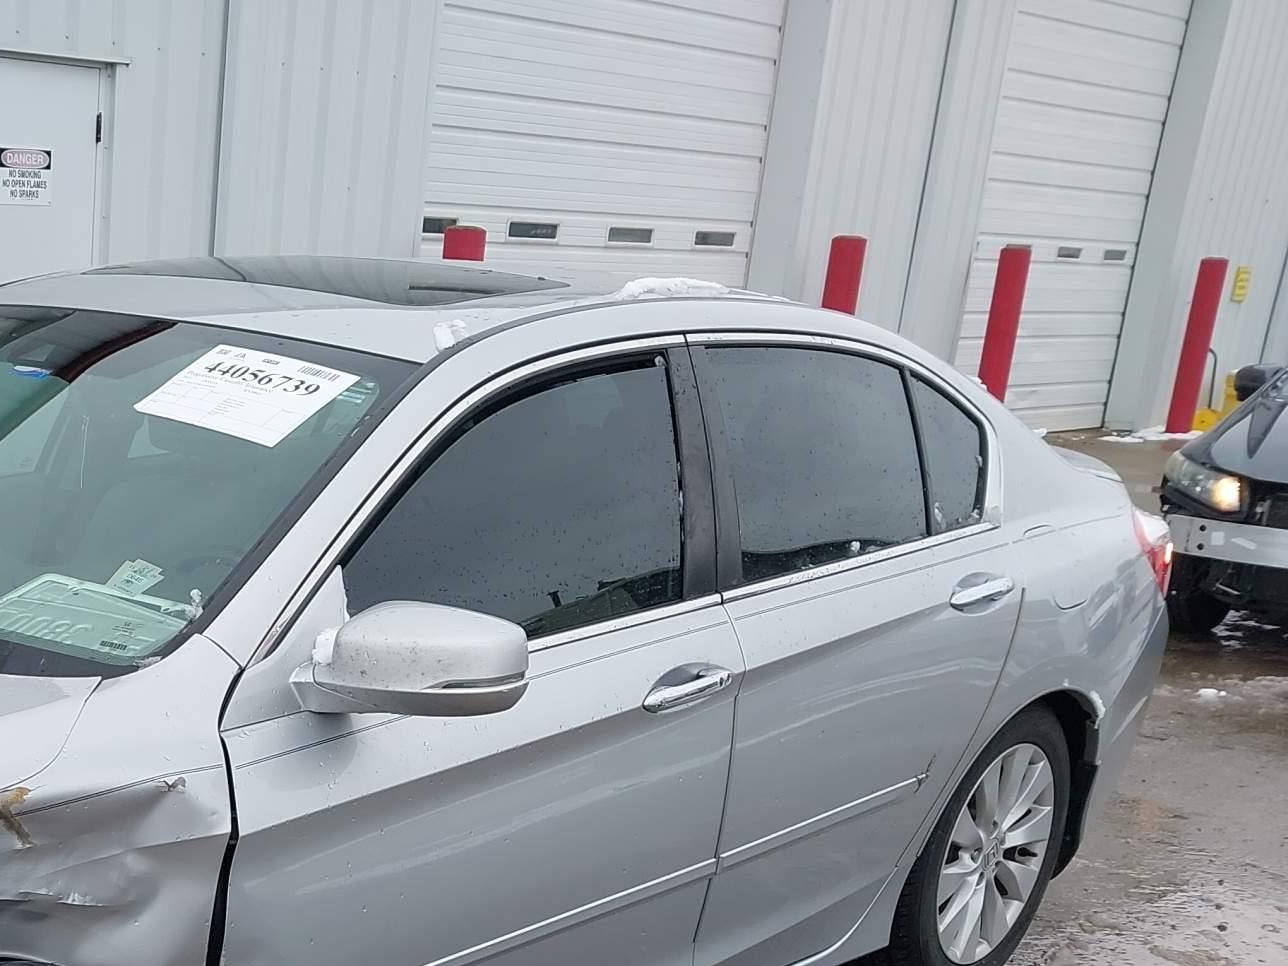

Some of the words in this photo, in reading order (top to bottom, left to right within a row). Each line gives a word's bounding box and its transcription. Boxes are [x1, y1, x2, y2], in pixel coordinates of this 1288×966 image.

[6, 152, 44, 164] DANGER
[9, 169, 17, 178] NO
[18, 170, 41, 179] SMOKING
[2, 179, 10, 187] NO
[11, 179, 26, 188] OPEN
[26, 180, 47, 190] FLAMES
[10, 189, 17, 198] NO
[19, 190, 39, 199] SPARKS
[204, 361, 321, 396] 44056739
